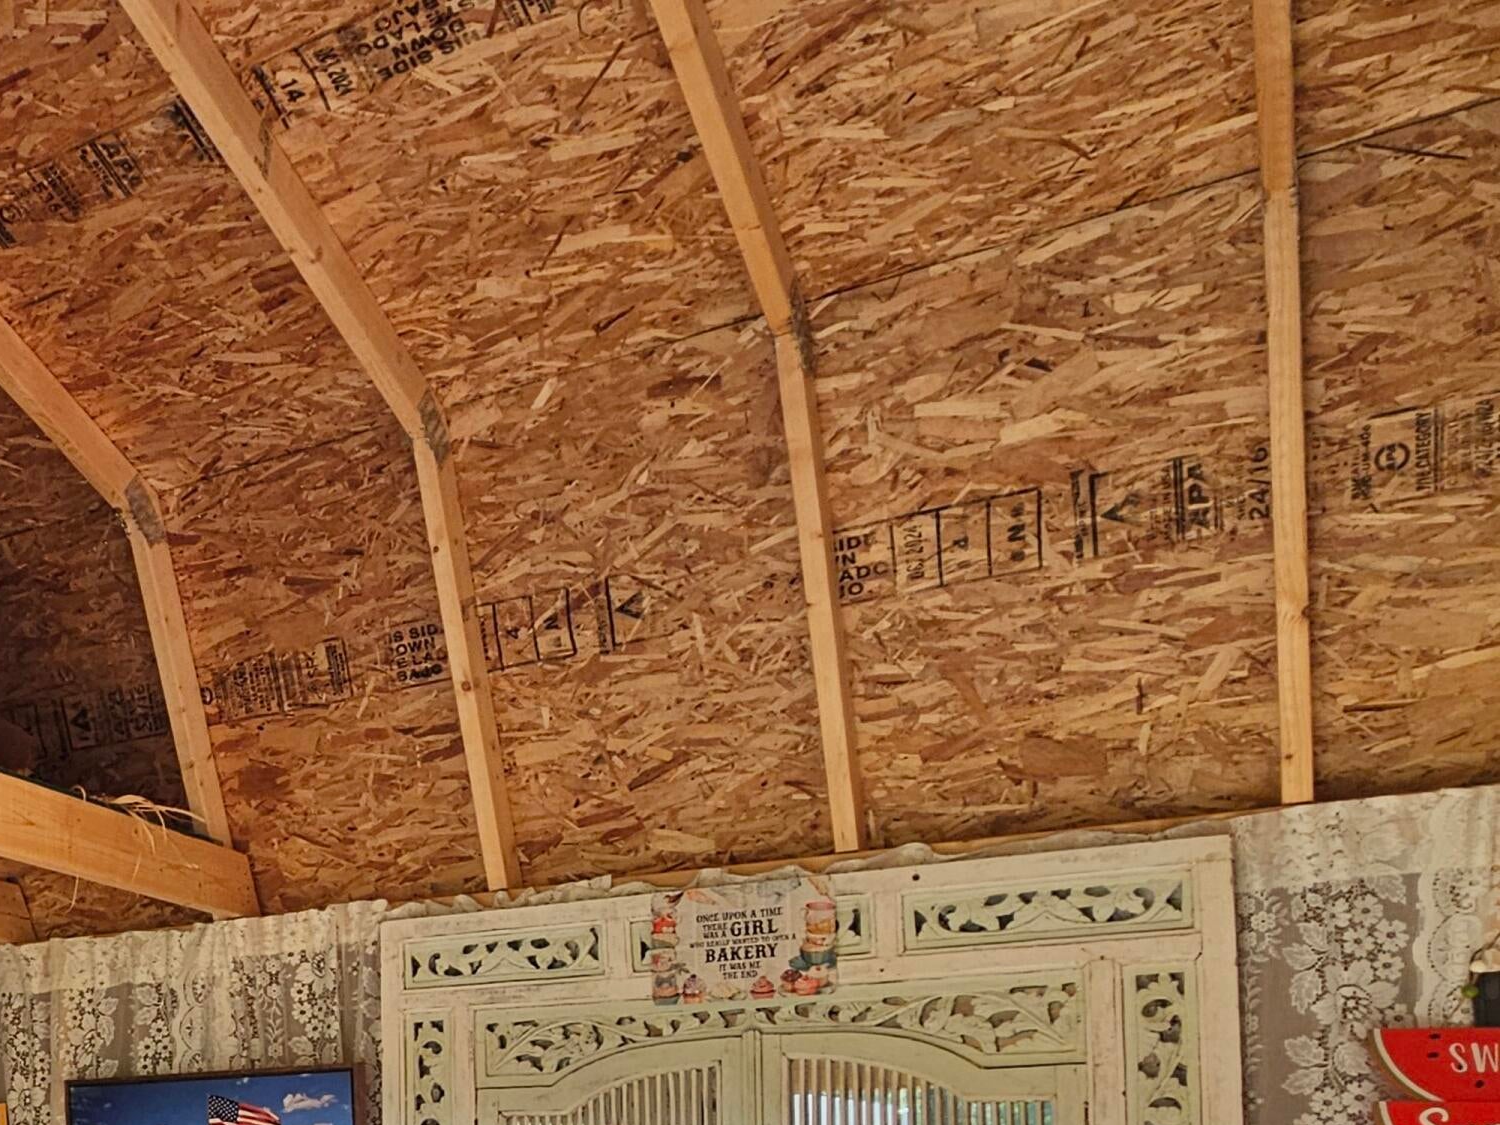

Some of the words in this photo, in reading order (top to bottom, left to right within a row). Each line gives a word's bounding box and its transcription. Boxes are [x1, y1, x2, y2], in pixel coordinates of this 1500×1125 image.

[696, 913, 719, 924] ONCE
[721, 911, 749, 921] UPON
[750, 909, 758, 919] A
[760, 907, 784, 917] TIME
[730, 918, 779, 938] GIRL
[703, 931, 719, 940] WAS
[720, 931, 727, 939] A
[705, 942, 778, 964] BAKERY
[728, 962, 747, 972] WAS
[722, 971, 739, 980] THE
[740, 970, 759, 980] END
